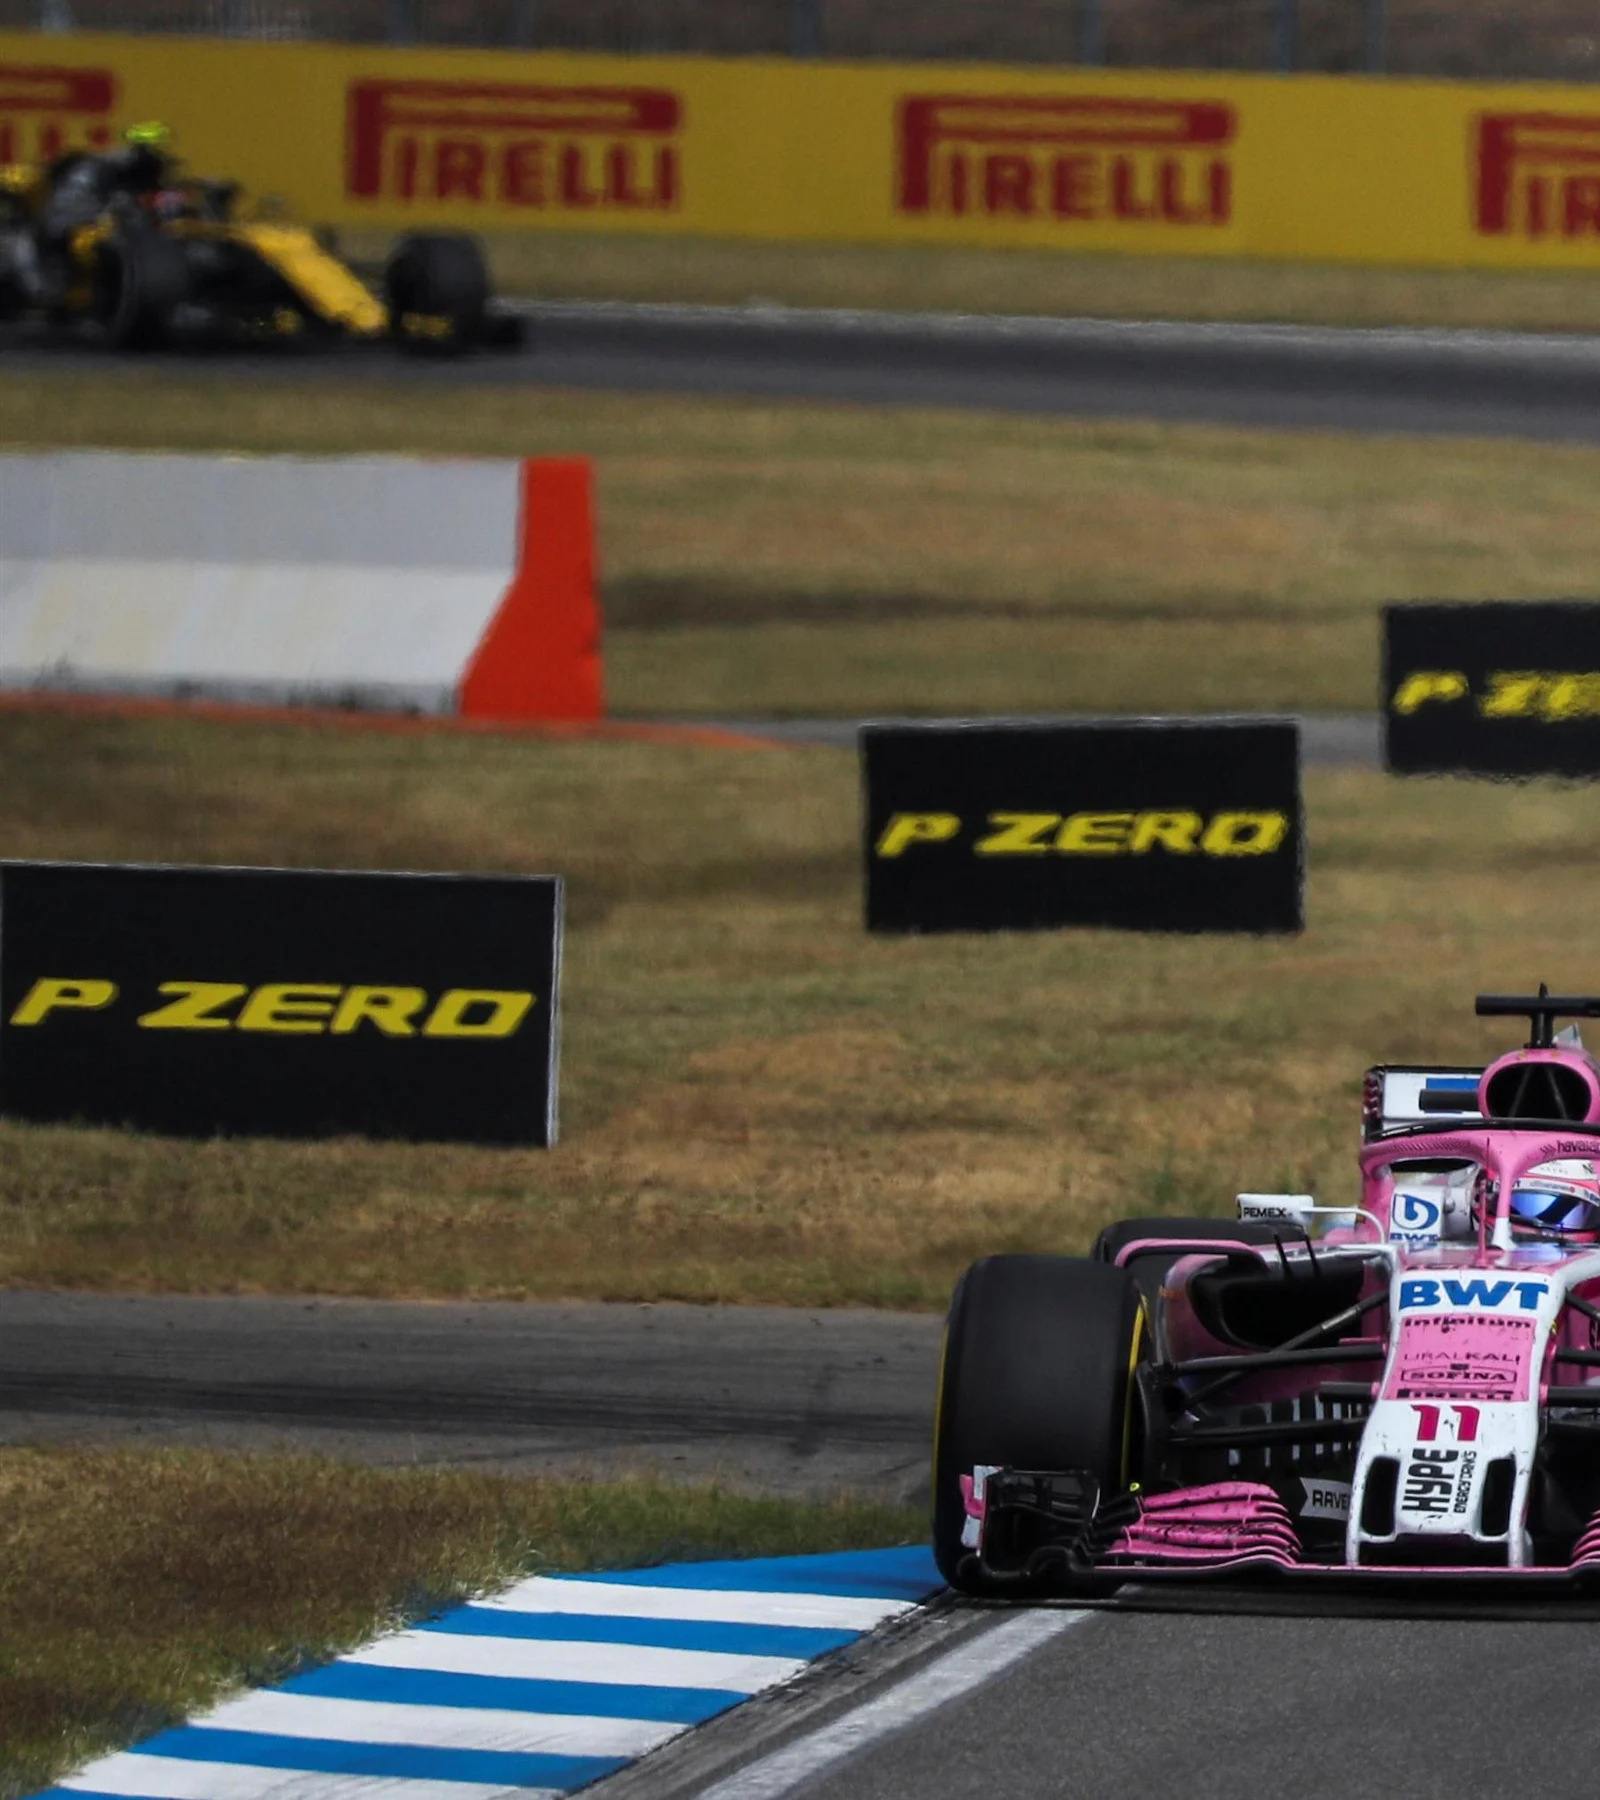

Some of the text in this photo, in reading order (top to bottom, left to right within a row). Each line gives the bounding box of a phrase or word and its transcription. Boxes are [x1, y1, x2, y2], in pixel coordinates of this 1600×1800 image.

[347, 79, 682, 207] PIRELLI
[898, 94, 1236, 224] PIRELLI
[1393, 670, 1469, 716] P
[876, 810, 1288, 857] P ZERO
[10, 977, 536, 1038] P ZERO
[1243, 1207, 1286, 1218] PEMEX
[1399, 1279, 1550, 1310] BWT
[1404, 1316, 1531, 1329] infinitum
[1404, 1352, 1520, 1365] URALKALI
[1410, 1371, 1508, 1382] SOFINA
[1410, 1404, 1480, 1441] 11
[1401, 1448, 1459, 1513] HYPE
[1312, 1489, 1351, 1511] RAVE
